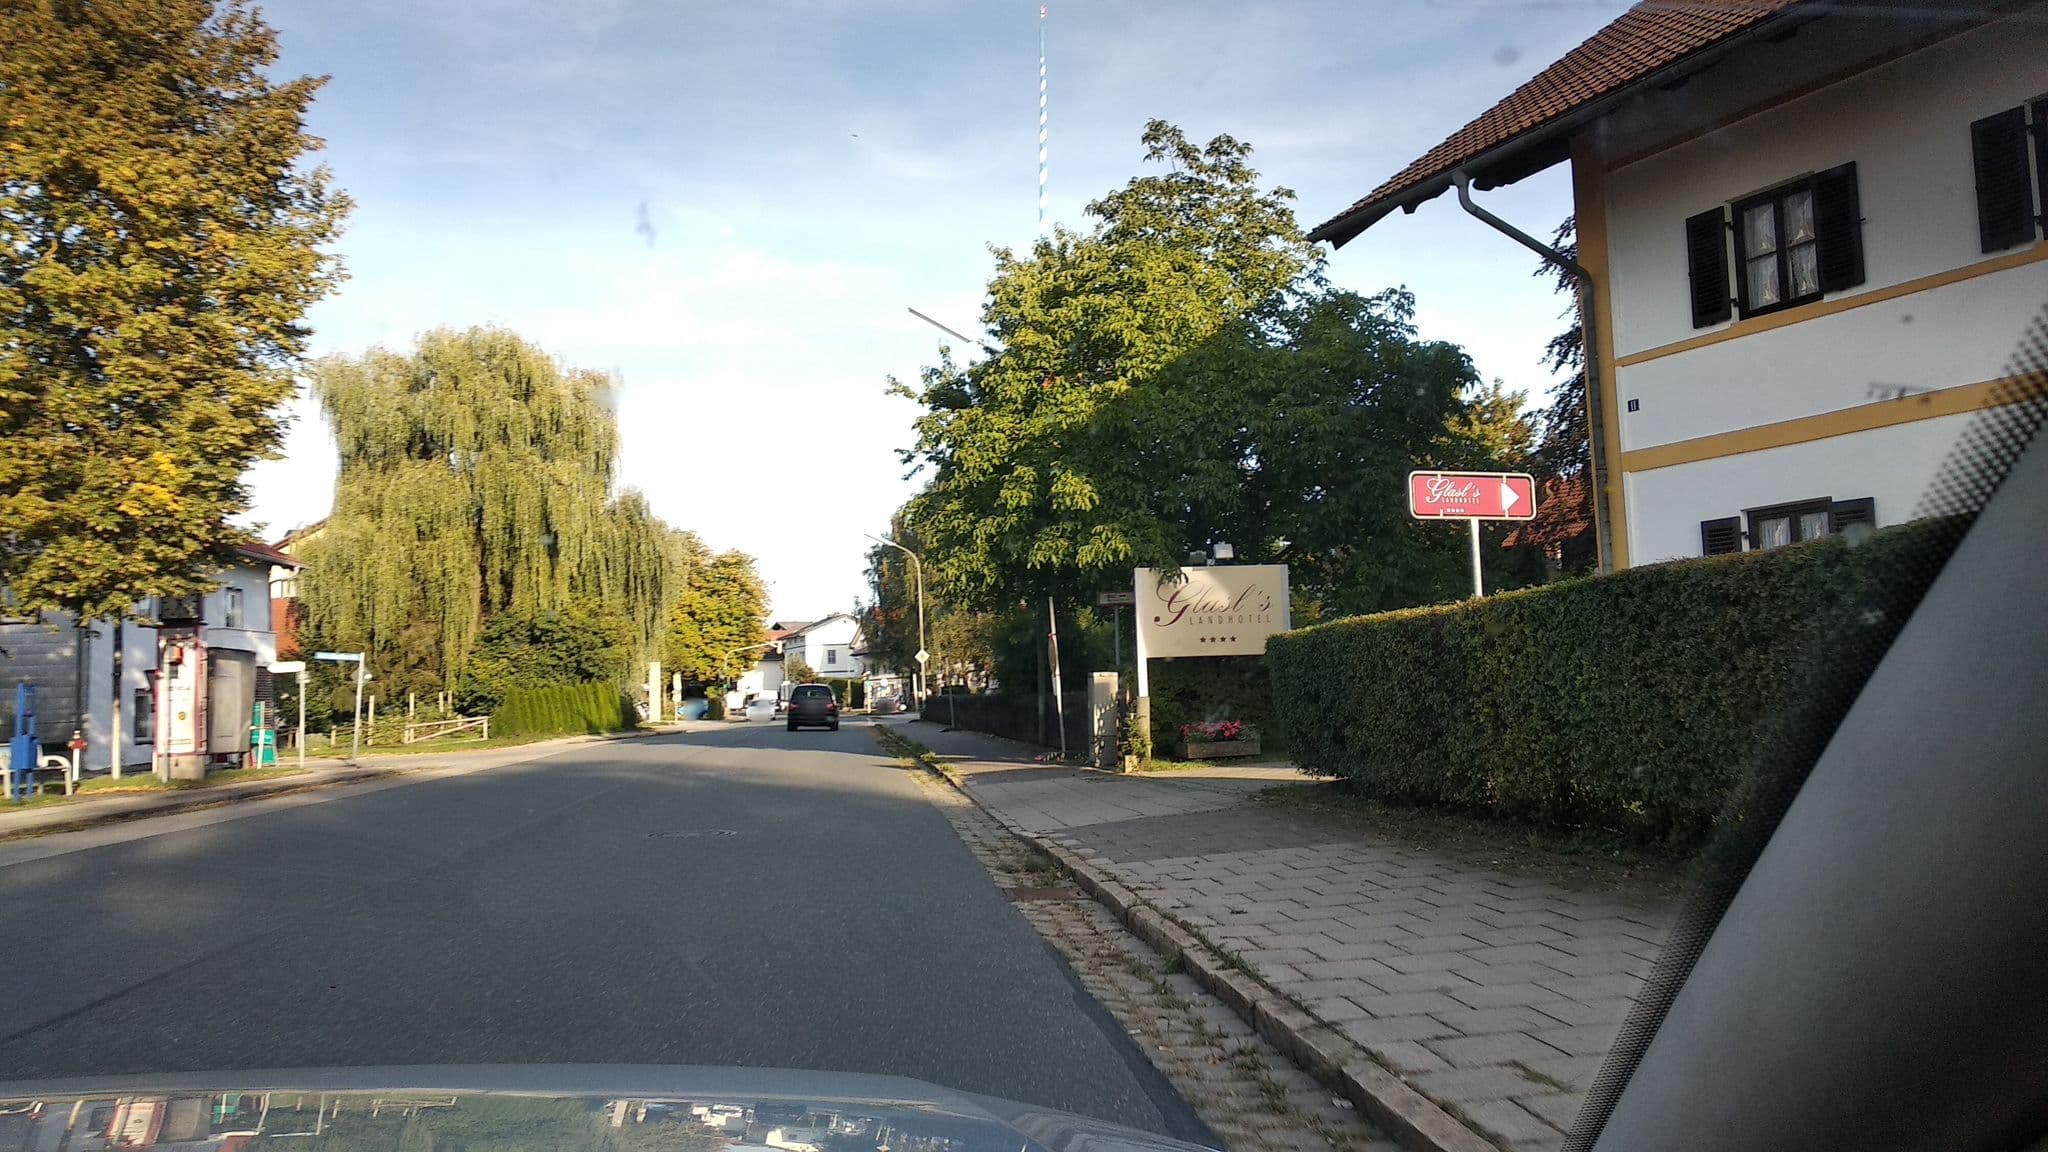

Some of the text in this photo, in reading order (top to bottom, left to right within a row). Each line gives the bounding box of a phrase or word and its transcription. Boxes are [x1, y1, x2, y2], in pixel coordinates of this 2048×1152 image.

[1425, 478, 1480, 503] Glasl's
[1154, 579, 1272, 627] Glasl's
[1189, 614, 1271, 626] LANDHOTEL
